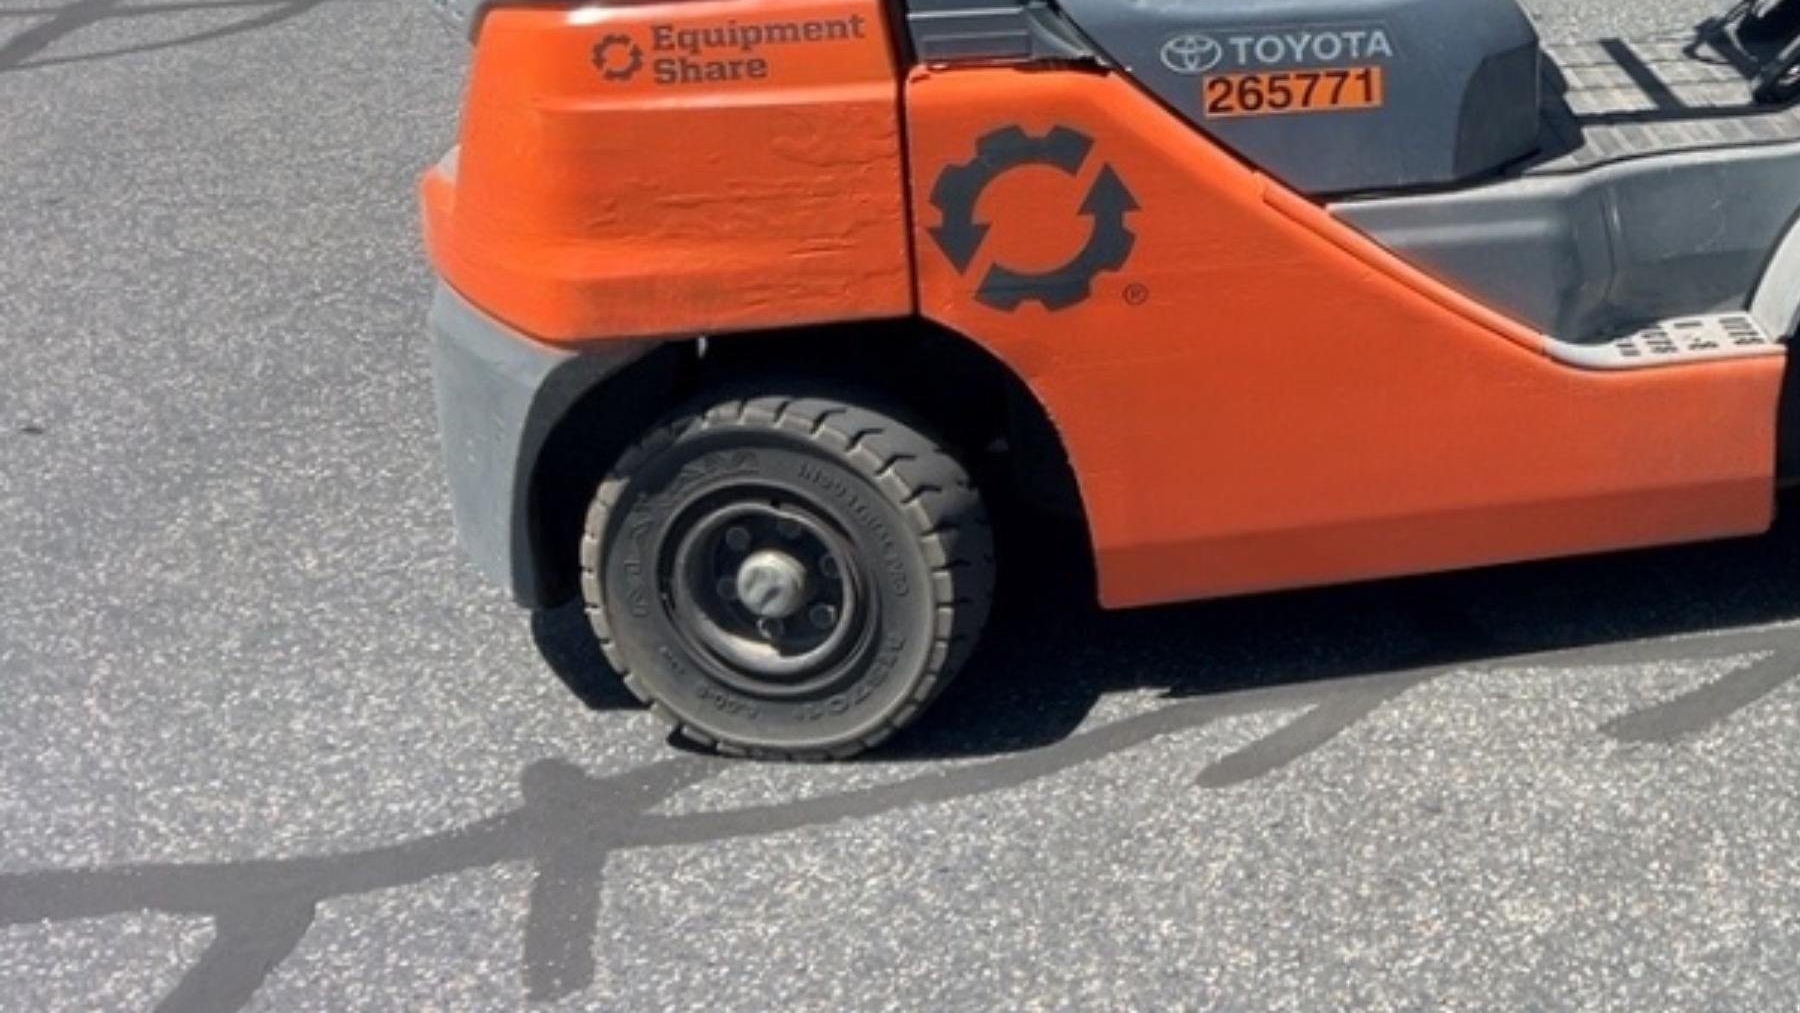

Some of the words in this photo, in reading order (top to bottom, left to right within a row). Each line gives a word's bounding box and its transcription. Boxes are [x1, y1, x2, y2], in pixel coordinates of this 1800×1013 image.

[650, 14, 866, 53] Equipment
[1229, 30, 1393, 65] TOYOTA
[653, 55, 768, 84] Share
[1206, 67, 1376, 115] 265771
